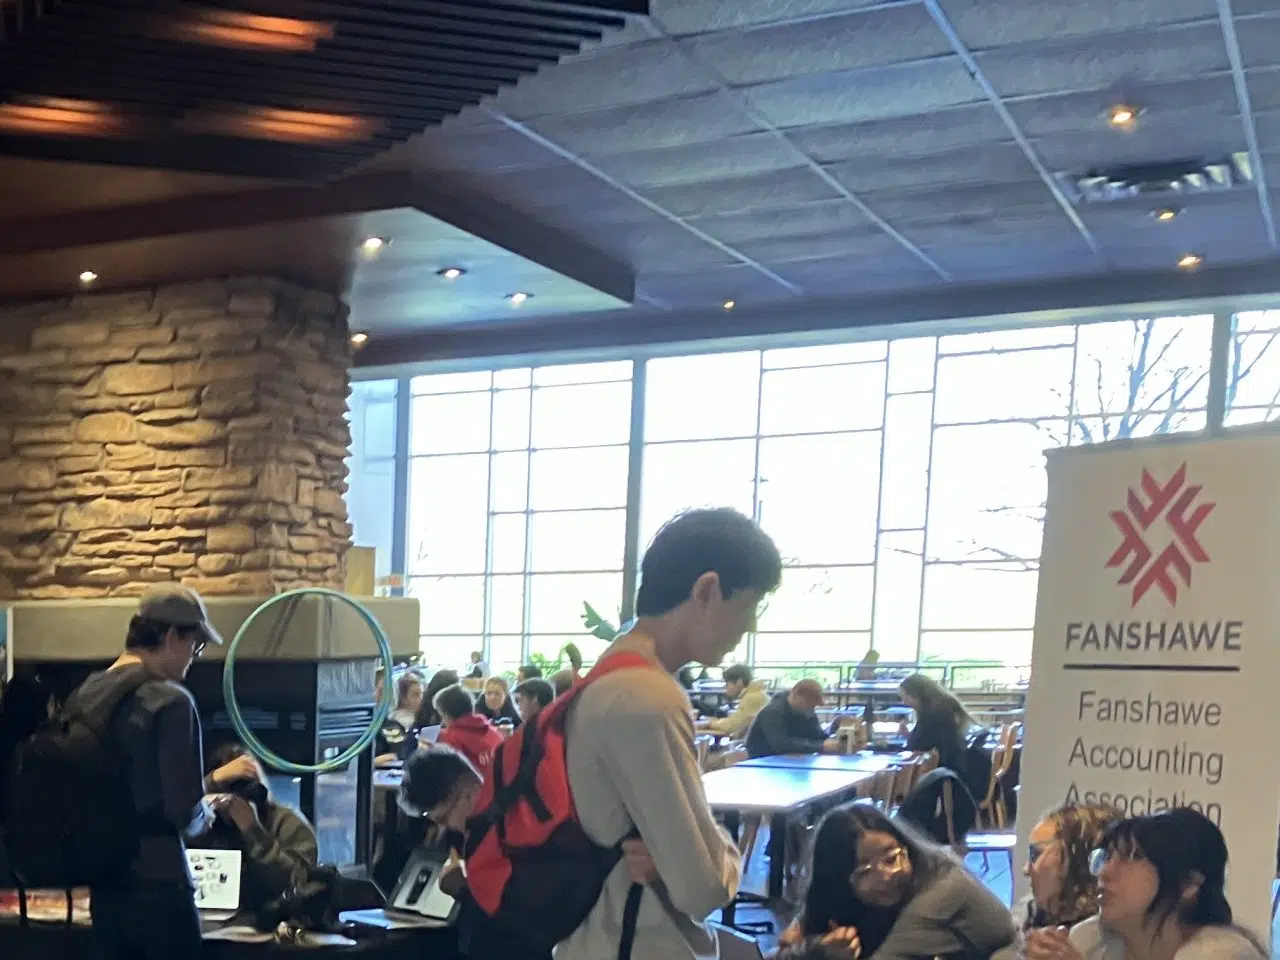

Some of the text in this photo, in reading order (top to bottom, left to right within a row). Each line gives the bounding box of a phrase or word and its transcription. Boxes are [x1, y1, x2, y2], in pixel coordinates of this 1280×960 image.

[1065, 620, 1243, 651] FANSHAWE
[1077, 690, 1222, 727] Fanshawe
[1068, 736, 1224, 785] Accounting
